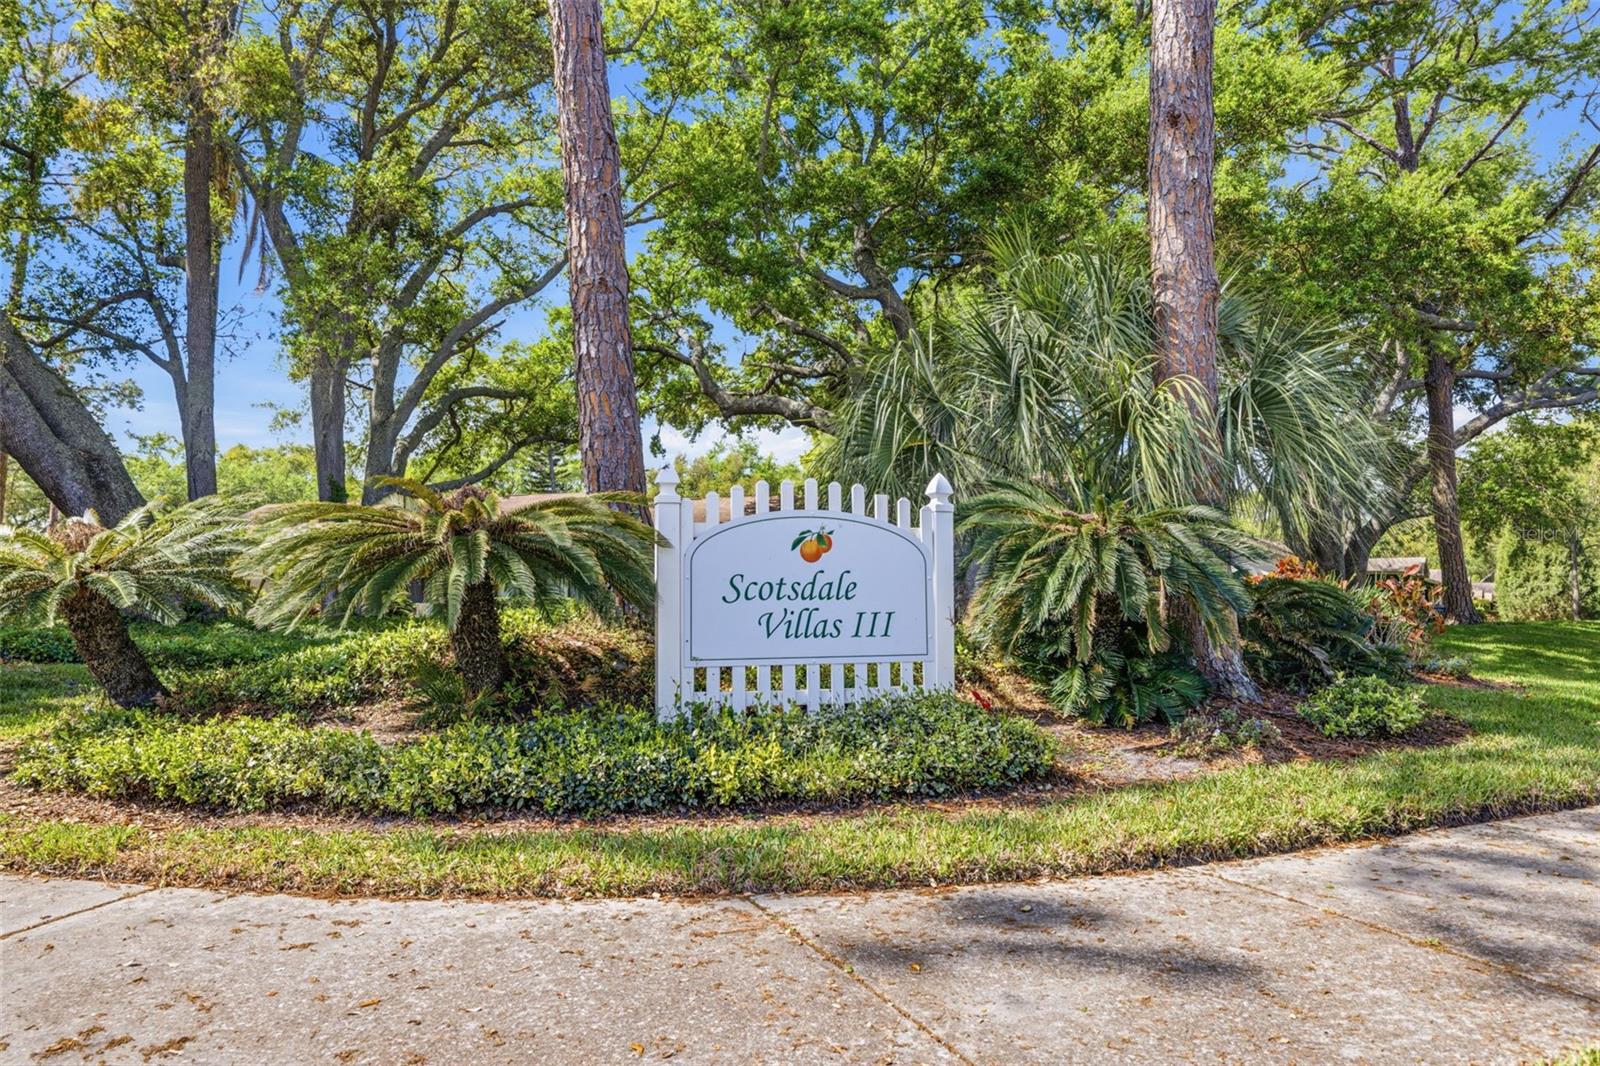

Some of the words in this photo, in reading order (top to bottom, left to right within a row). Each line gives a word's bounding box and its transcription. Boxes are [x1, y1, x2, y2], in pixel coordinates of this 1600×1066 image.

[721, 569, 858, 604] Scotsdale
[757, 607, 844, 640] Villas
[850, 611, 896, 639] III
